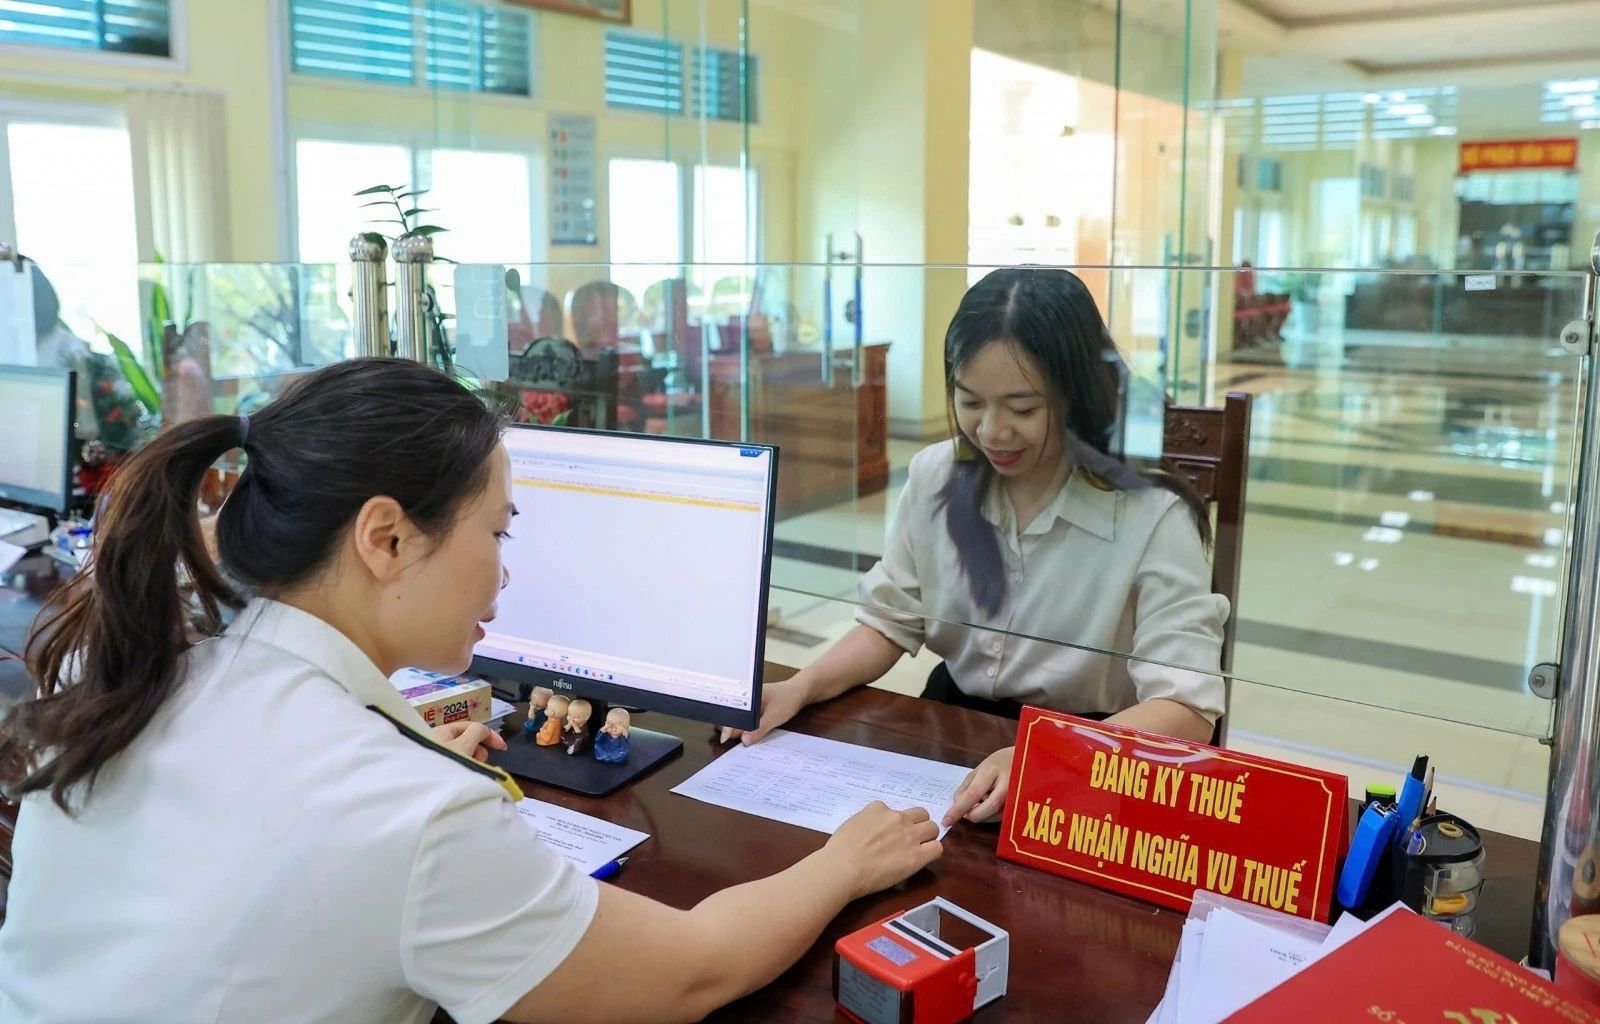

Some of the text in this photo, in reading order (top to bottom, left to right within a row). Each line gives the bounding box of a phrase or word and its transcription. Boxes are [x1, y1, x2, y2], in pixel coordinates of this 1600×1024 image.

[444, 700, 467, 715] 2024
[553, 679, 572, 690] FUJITSU
[1090, 746, 1250, 824] ĐĂNG KÝ THUẾ
[1022, 798, 1065, 846] XÁC
[1067, 813, 1129, 868] NHẬN
[1130, 830, 1199, 886] NGHĨA
[1242, 859, 1308, 914] THUẾ
